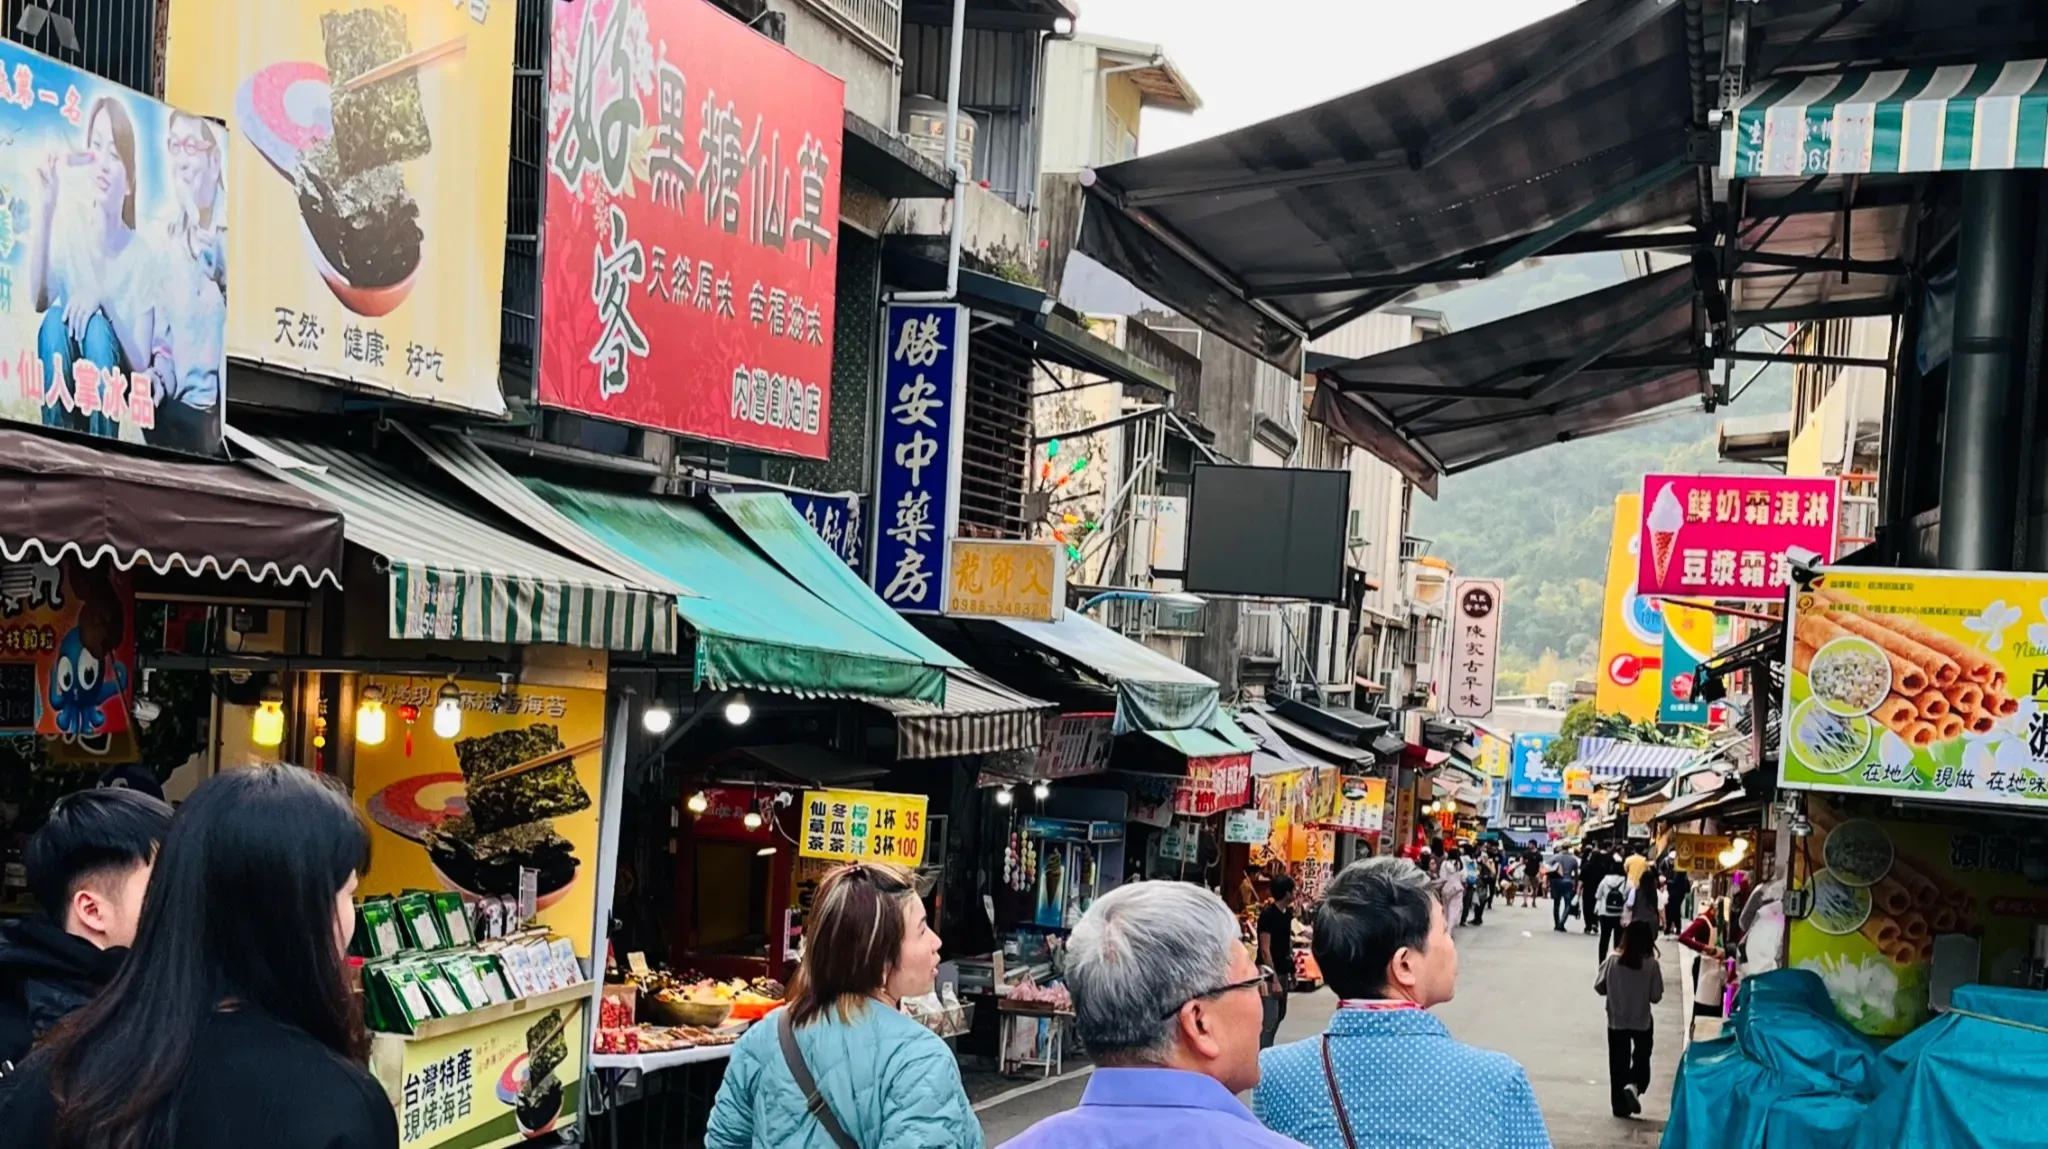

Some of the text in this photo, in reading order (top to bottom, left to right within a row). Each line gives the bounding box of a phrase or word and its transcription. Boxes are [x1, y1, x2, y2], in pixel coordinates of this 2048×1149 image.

[648, 64, 835, 269] 黑糖仙草
[647, 245, 824, 347] 天然原味 幸福滋味
[406, 341, 444, 383] 好吃
[731, 364, 822, 435] 內灣創始店
[884, 313, 948, 603] 勝安中藥房
[1686, 488, 1829, 527] 鮮奶霜淇淋
[955, 550, 1050, 597] 龍師父
[1681, 549, 1799, 588] 豆漿霜淇
[1461, 624, 1487, 708] 陳家古早味
[1863, 763, 2048, 793] 在地人 現做 在地味
[807, 800, 827, 851] 仙草茶
[829, 802, 847, 853] 冬瓜茶
[875, 808, 919, 831] 1杯 35
[874, 835, 918, 858] 3杯 100
[403, 1047, 473, 1110] 台灣特產
[403, 1083, 474, 1143] 現烤海苔
